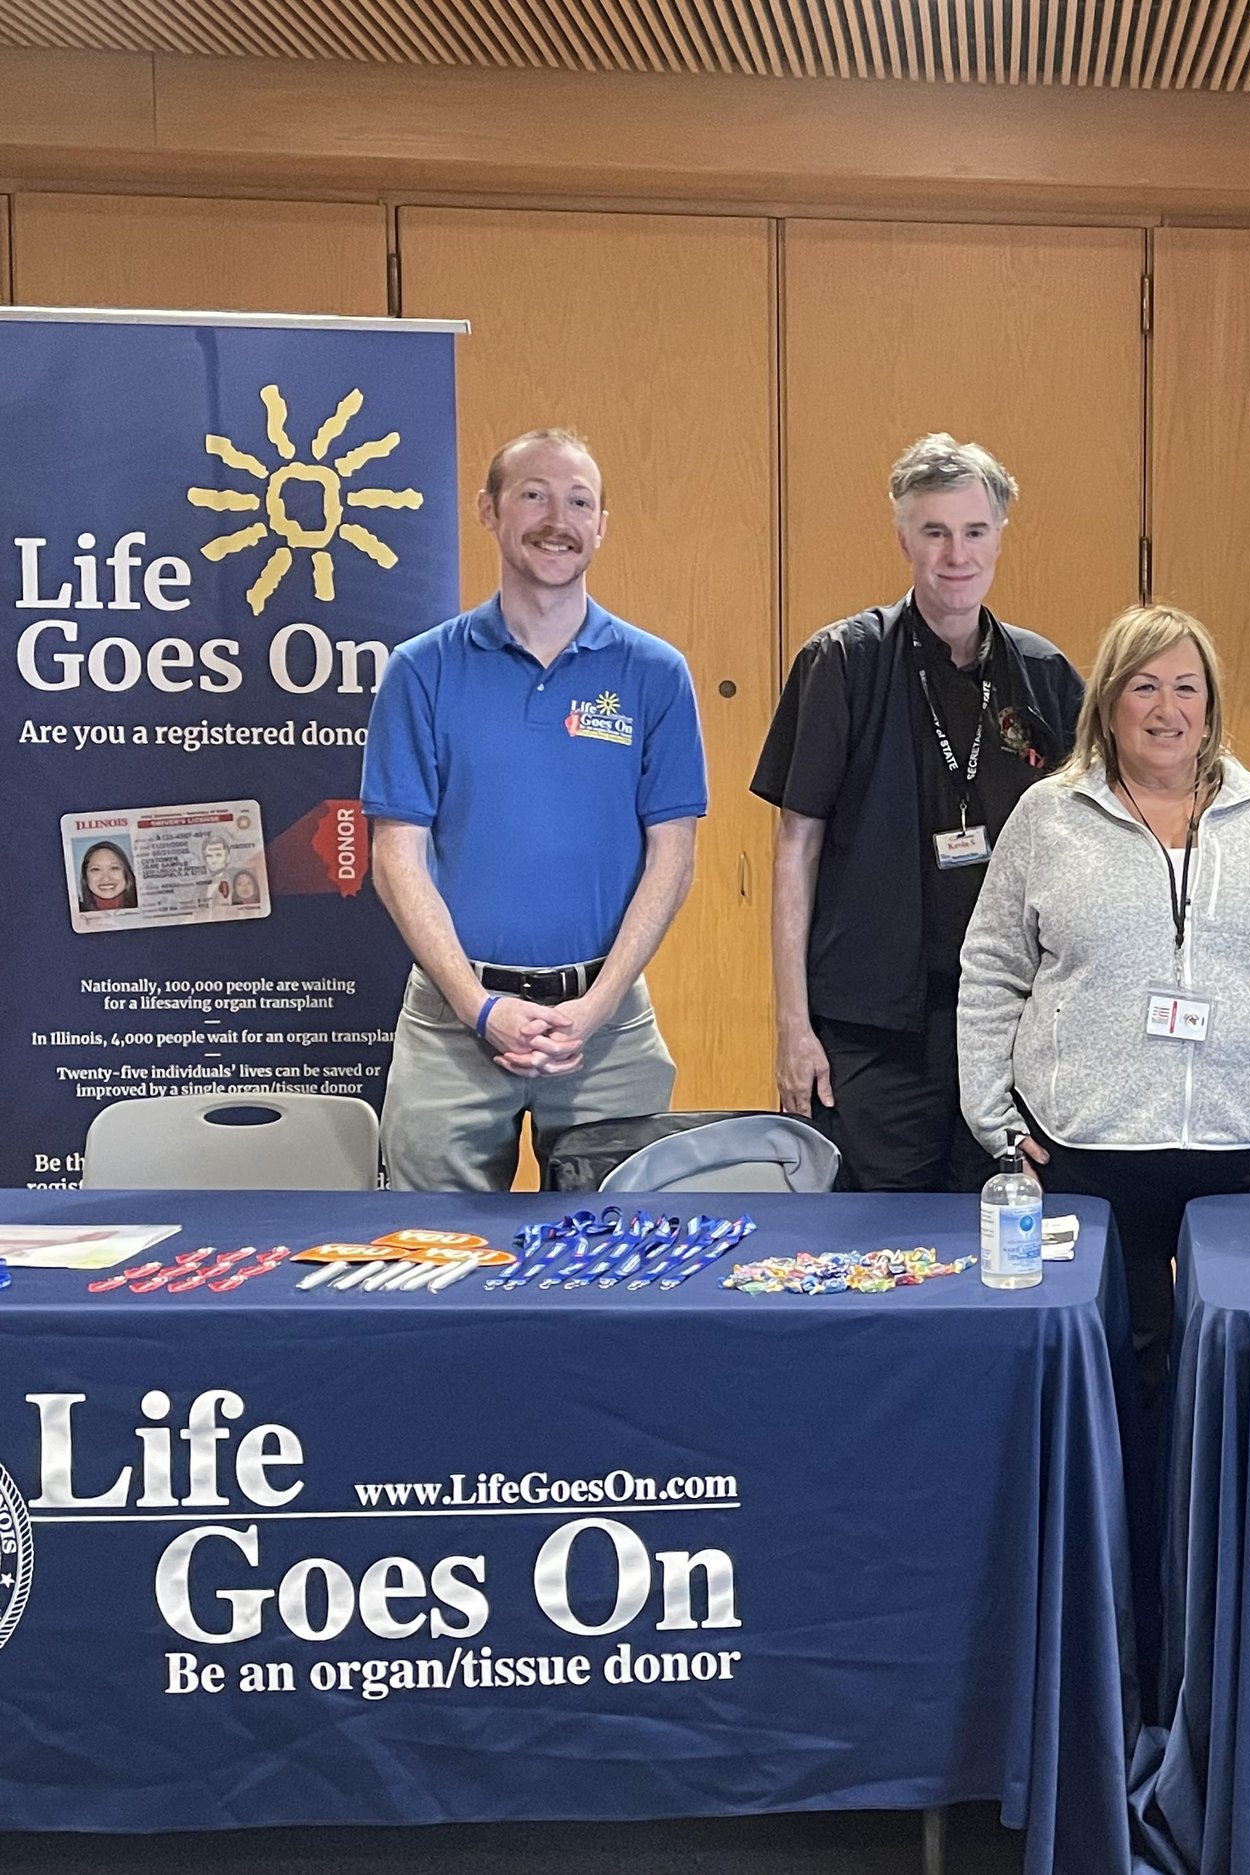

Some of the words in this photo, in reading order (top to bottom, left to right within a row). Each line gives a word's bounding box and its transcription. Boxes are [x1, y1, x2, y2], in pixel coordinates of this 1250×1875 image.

[14, 532, 191, 611] Life
[16, 619, 243, 693] Goes
[269, 623, 390, 694] On
[19, 720, 67, 745] Are
[73, 725, 126, 751] you
[132, 726, 148, 745] a
[154, 720, 295, 752] registered
[301, 720, 368, 746] dono
[580, 714, 612, 730] Goes
[615, 719, 633, 734] On
[940, 740, 959, 771] STATE
[75, 817, 129, 831] ILLINOIS
[337, 808, 356, 879] DONOR
[80, 978, 162, 995] Nationally,
[165, 980, 223, 995] 100,000
[226, 978, 275, 995] people
[276, 980, 300, 992] are
[301, 978, 356, 995] waiting
[104, 996, 125, 1010] for
[128, 999, 138, 1010] a
[140, 996, 212, 1013] lifesaving
[214, 998, 257, 1013] organ
[260, 995, 335, 1012] transplant
[31, 1032, 47, 1046] In
[50, 1031, 108, 1048] Illinois,
[110, 1032, 154, 1048] 4,000
[156, 1030, 205, 1047] people
[206, 1030, 239, 1044] wait
[241, 1029, 263, 1044] for
[265, 1032, 284, 1043] an
[286, 1031, 328, 1046] organ
[331, 1029, 395, 1046] transpla
[56, 1065, 149, 1083] Twenty-five
[239, 1064, 273, 1078] lives
[275, 1066, 300, 1078] can
[303, 1064, 320, 1078] be
[322, 1063, 363, 1077] saved
[365, 1065, 381, 1077] or
[76, 1082, 147, 1100] improved
[149, 1081, 168, 1097] by
[169, 1088, 179, 1096] a
[181, 1081, 225, 1096] single
[227, 1080, 318, 1095] organ/tissue
[320, 1081, 363, 1094] donor
[34, 1153, 61, 1172] Be
[66, 1152, 86, 1172] th
[26, 1390, 305, 1509] Life
[354, 1469, 739, 1507] www.LifeGoesOn.com
[155, 1524, 490, 1645] Goes
[533, 1517, 743, 1637] On
[164, 1652, 226, 1695] Be
[239, 1665, 297, 1694] an
[309, 1647, 592, 1701] organ/tissue
[603, 1643, 743, 1684] donor
